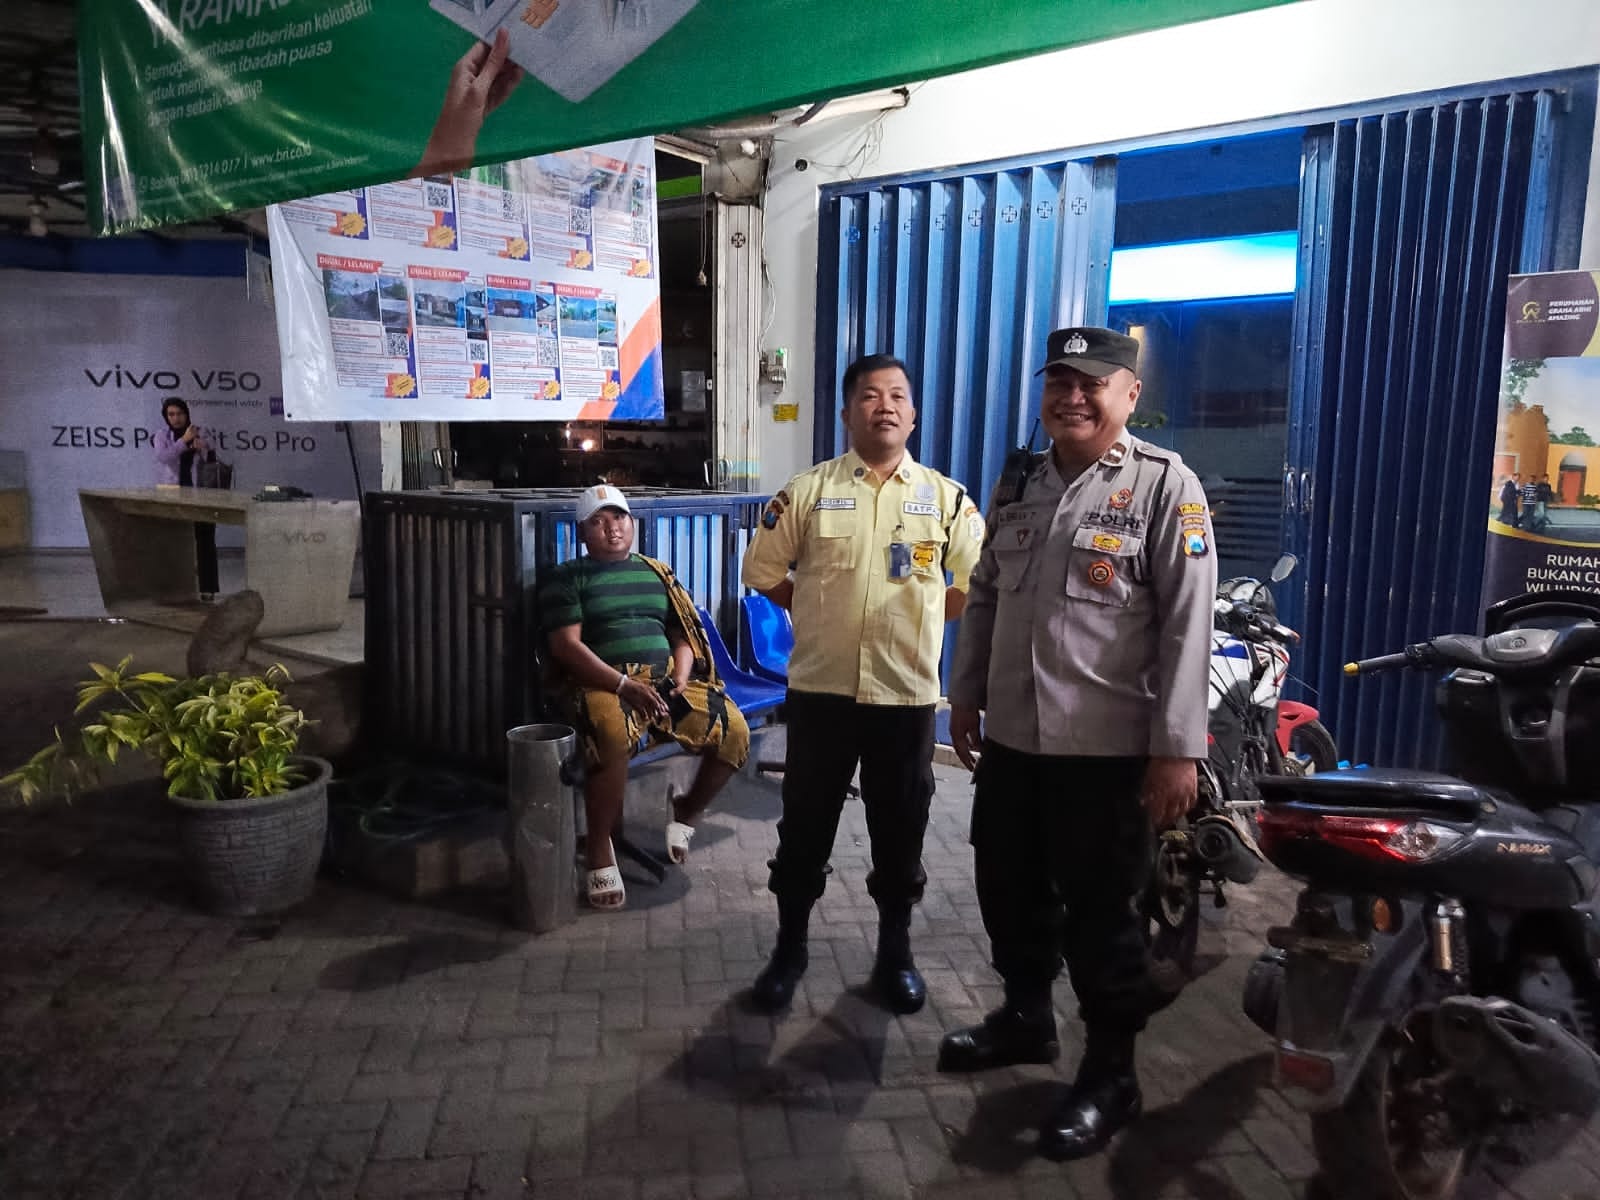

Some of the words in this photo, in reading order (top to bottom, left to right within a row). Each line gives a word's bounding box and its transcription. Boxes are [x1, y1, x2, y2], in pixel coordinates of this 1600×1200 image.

[246, 22, 313, 50] diberikan
[314, 2, 373, 33] kekuatan
[146, 83, 175, 105] ntuk
[289, 40, 333, 67] puasa
[84, 364, 181, 390] vivo
[191, 369, 262, 392] V50
[51, 425, 126, 449] ZEISS
[235, 430, 268, 452] So
[275, 431, 317, 453] Pro
[1087, 512, 1141, 530] POLRI
[1527, 567, 1581, 583] BUKAN
